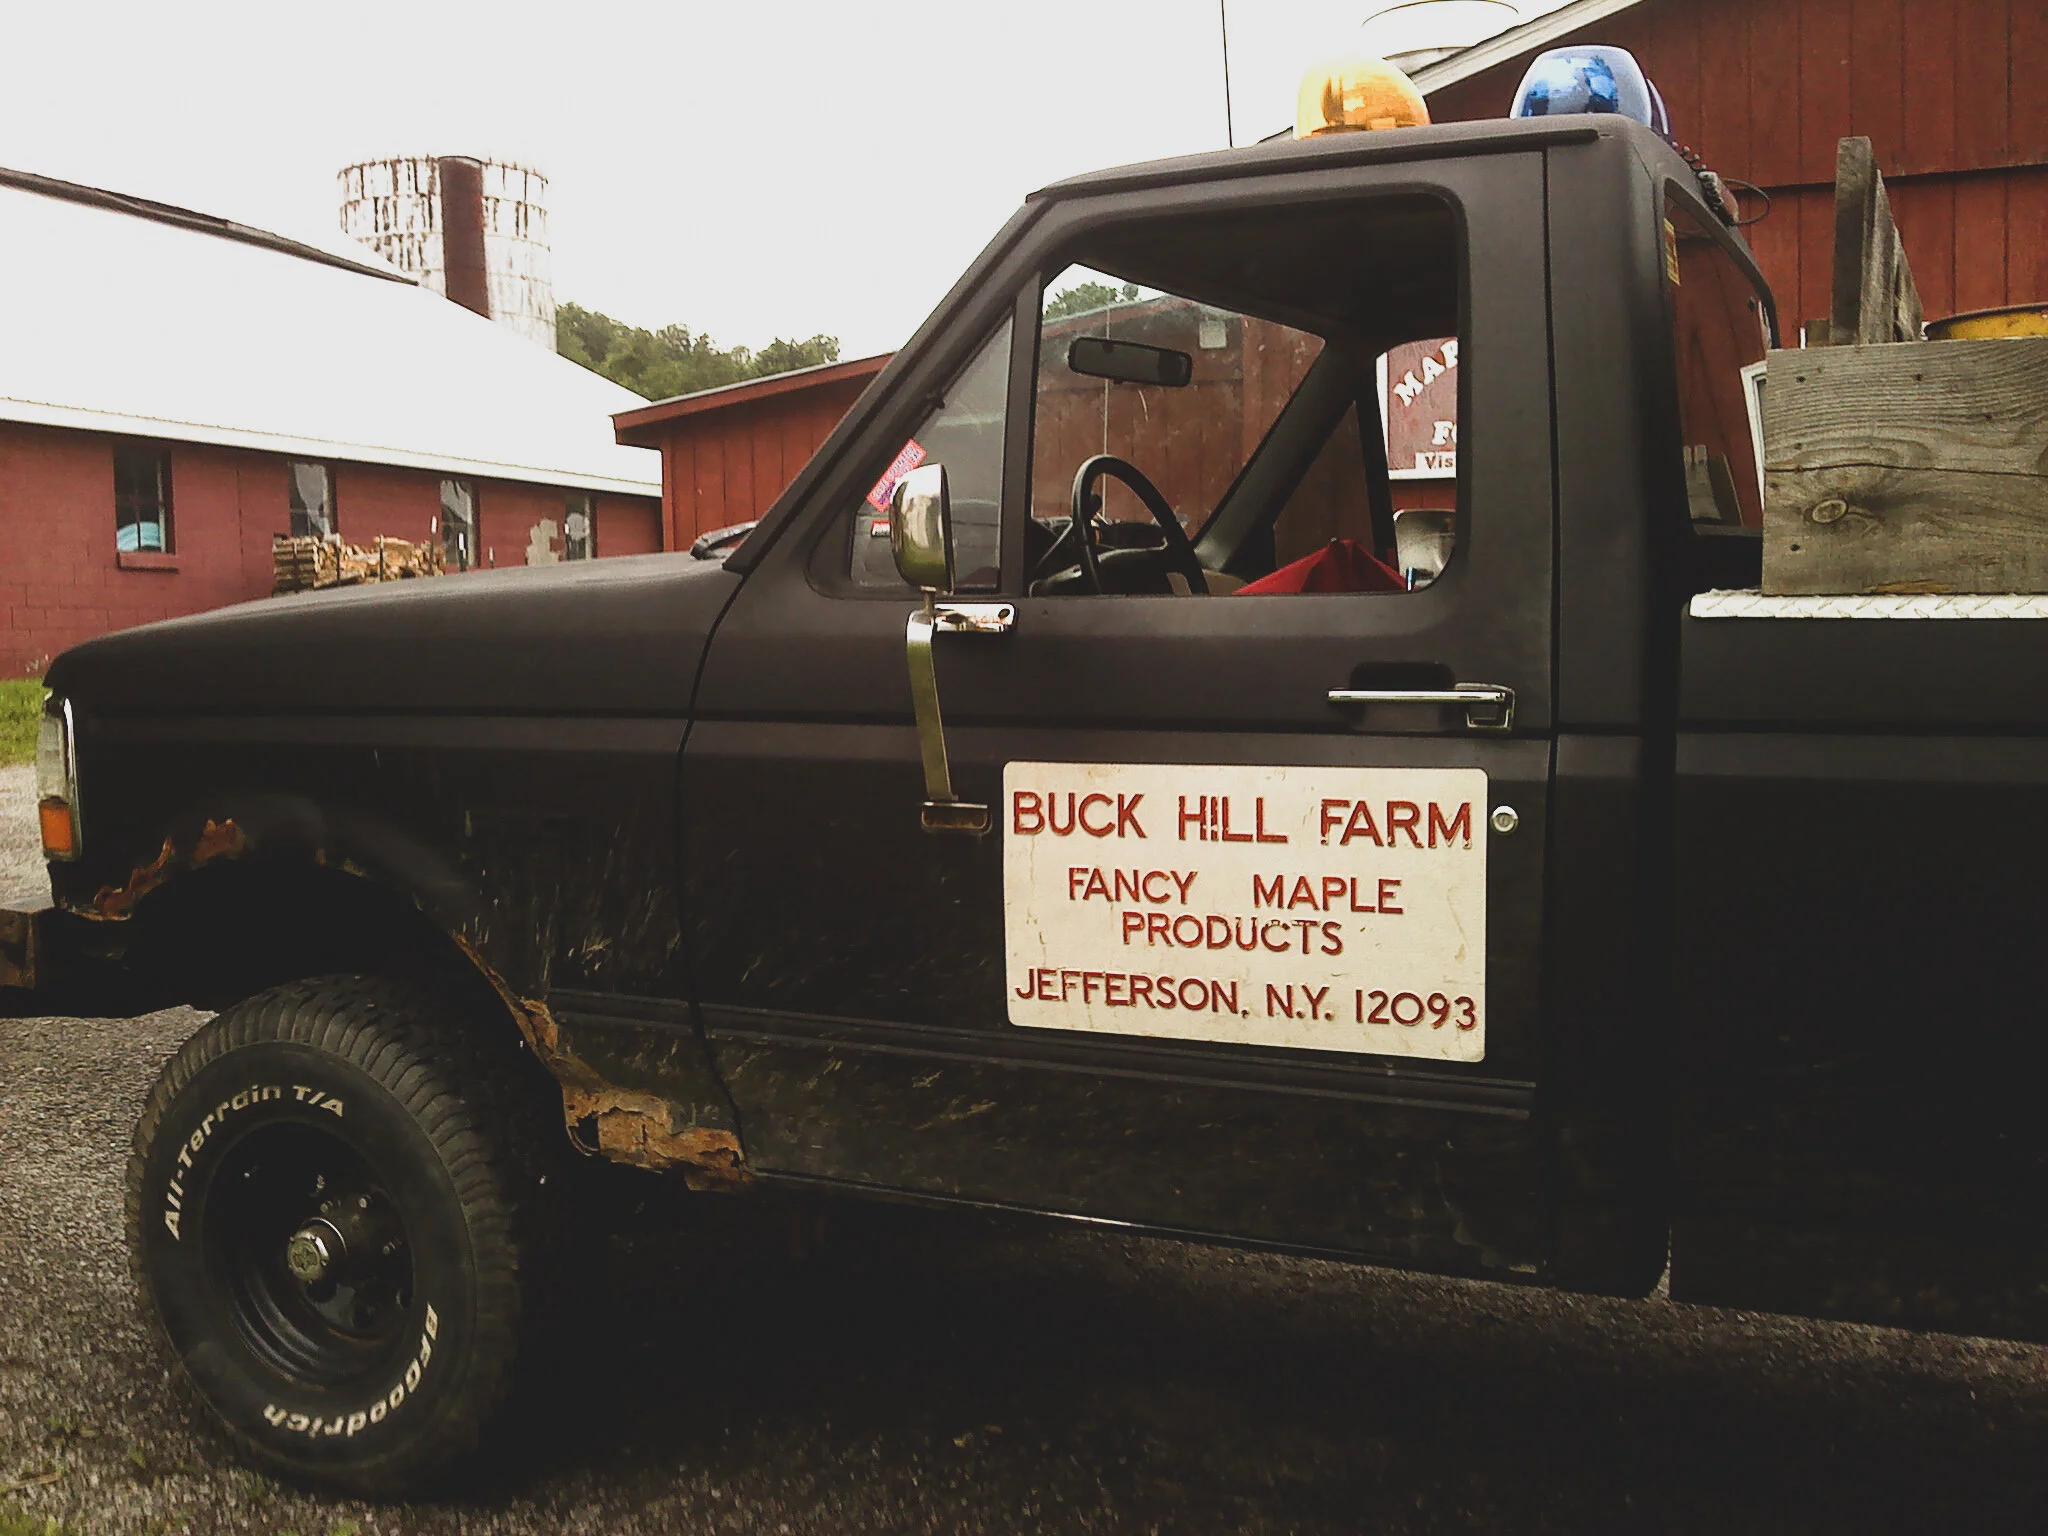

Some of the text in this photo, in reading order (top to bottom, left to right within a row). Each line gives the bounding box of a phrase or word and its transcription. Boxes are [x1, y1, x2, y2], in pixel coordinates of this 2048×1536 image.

[1432, 420, 1457, 445] F
[1013, 791, 1473, 849] BUCK HILL FARM
[1068, 867, 1404, 915] FANCY MAPLE
[1122, 911, 1344, 955] PRODUCTS
[1267, 983, 1334, 1020] N.Y.
[1355, 989, 1477, 1031] 12093
[164, 1084, 345, 1241] All-Terrain T/A
